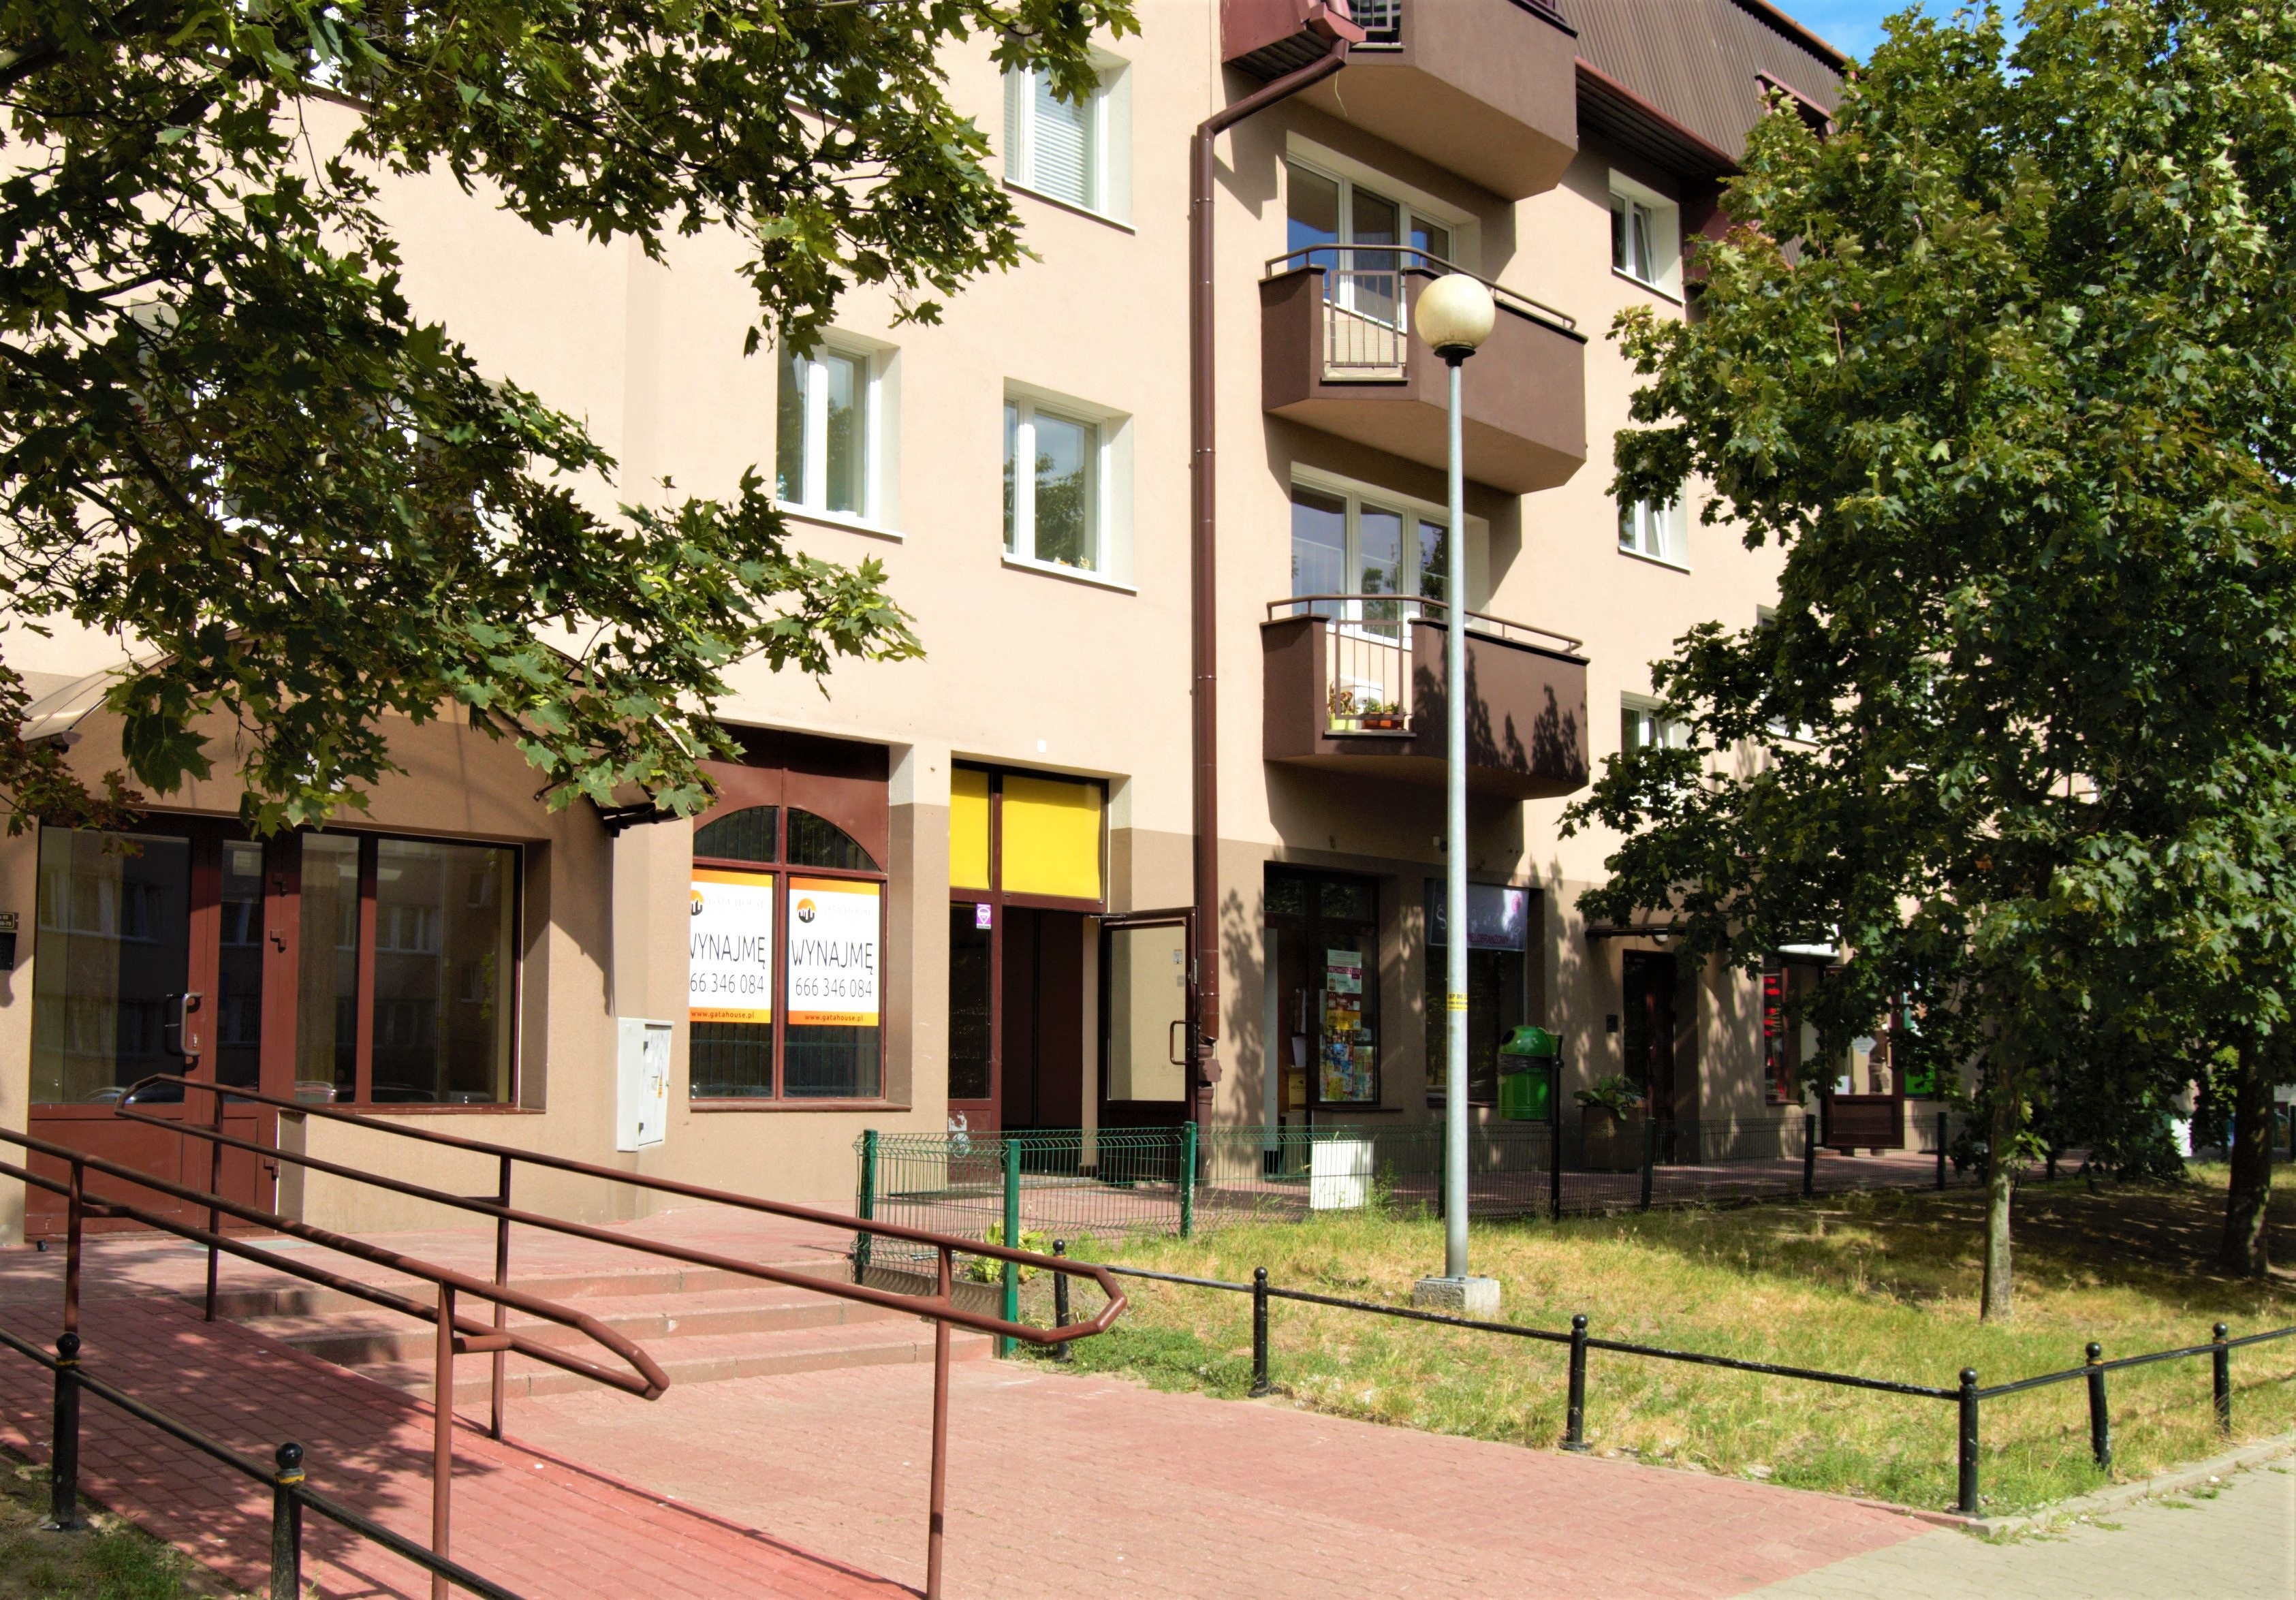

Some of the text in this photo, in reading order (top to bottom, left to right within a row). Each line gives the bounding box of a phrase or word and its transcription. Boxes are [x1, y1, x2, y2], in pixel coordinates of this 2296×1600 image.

[791, 939, 872, 975] WYNAJMĘ
[711, 973, 736, 993] 346
[740, 975, 764, 994] 084
[796, 977, 872, 997] 666 346 084
[691, 1011, 755, 1019] www.gatahouse.pl
[804, 1014, 864, 1022] www.gatahouse.pl
